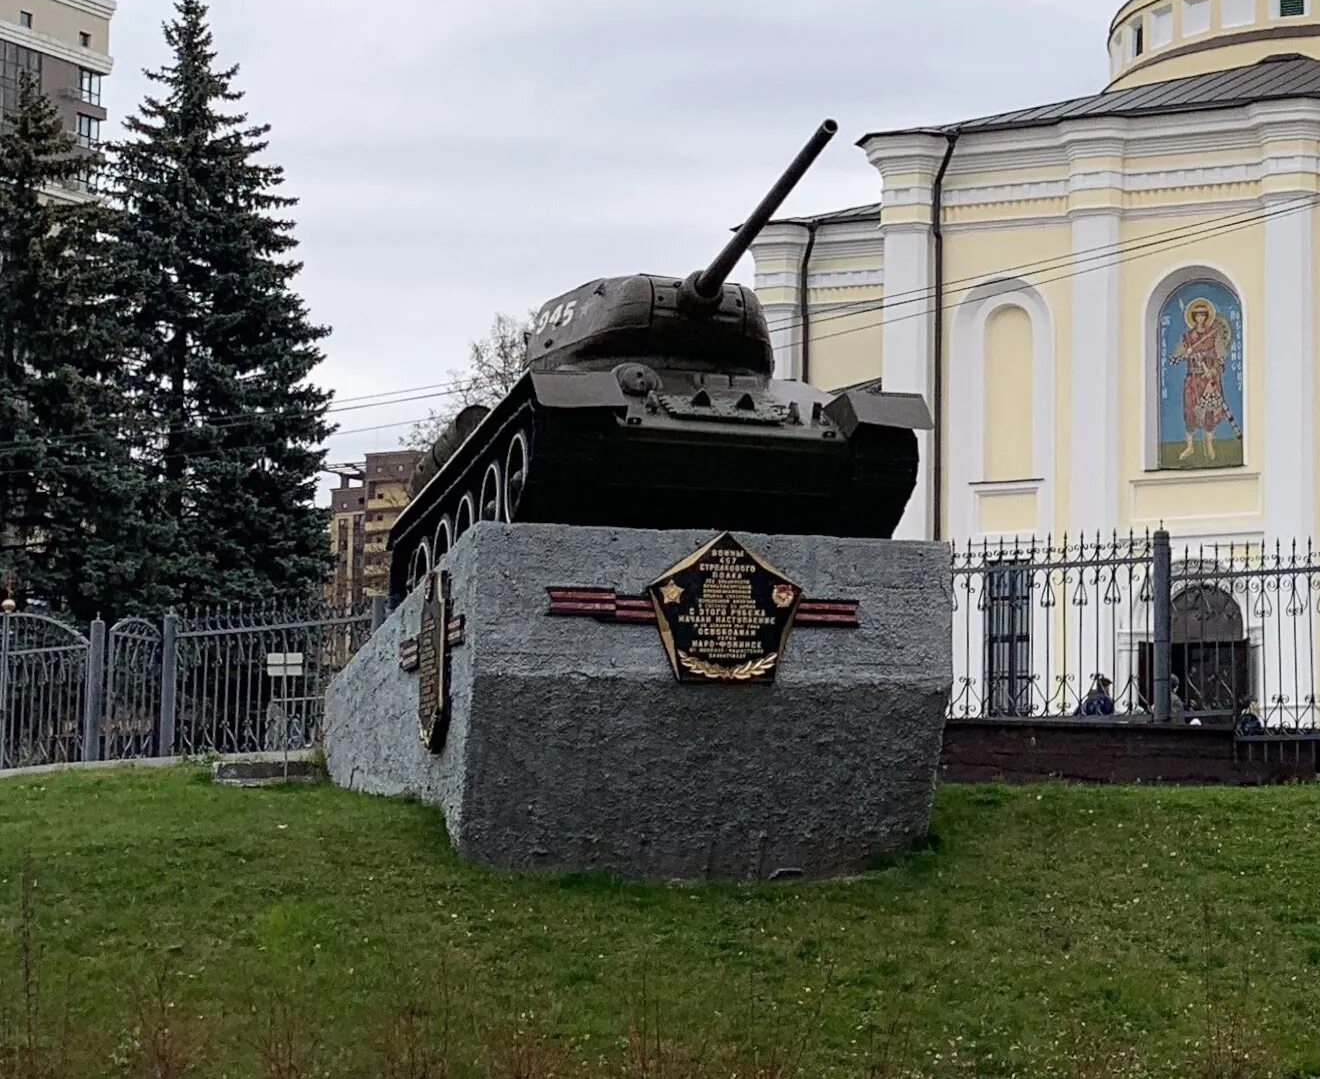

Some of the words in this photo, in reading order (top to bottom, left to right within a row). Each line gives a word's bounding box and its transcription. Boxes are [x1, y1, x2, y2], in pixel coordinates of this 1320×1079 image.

[678, 615, 712, 623] НАЧАЛИ
[715, 616, 776, 624] НАСТУПЛЕНИЕ
[698, 628, 756, 636] ОСВОБОДИЛИ
[691, 640, 762, 648] НАРО-ФОМИНСК
